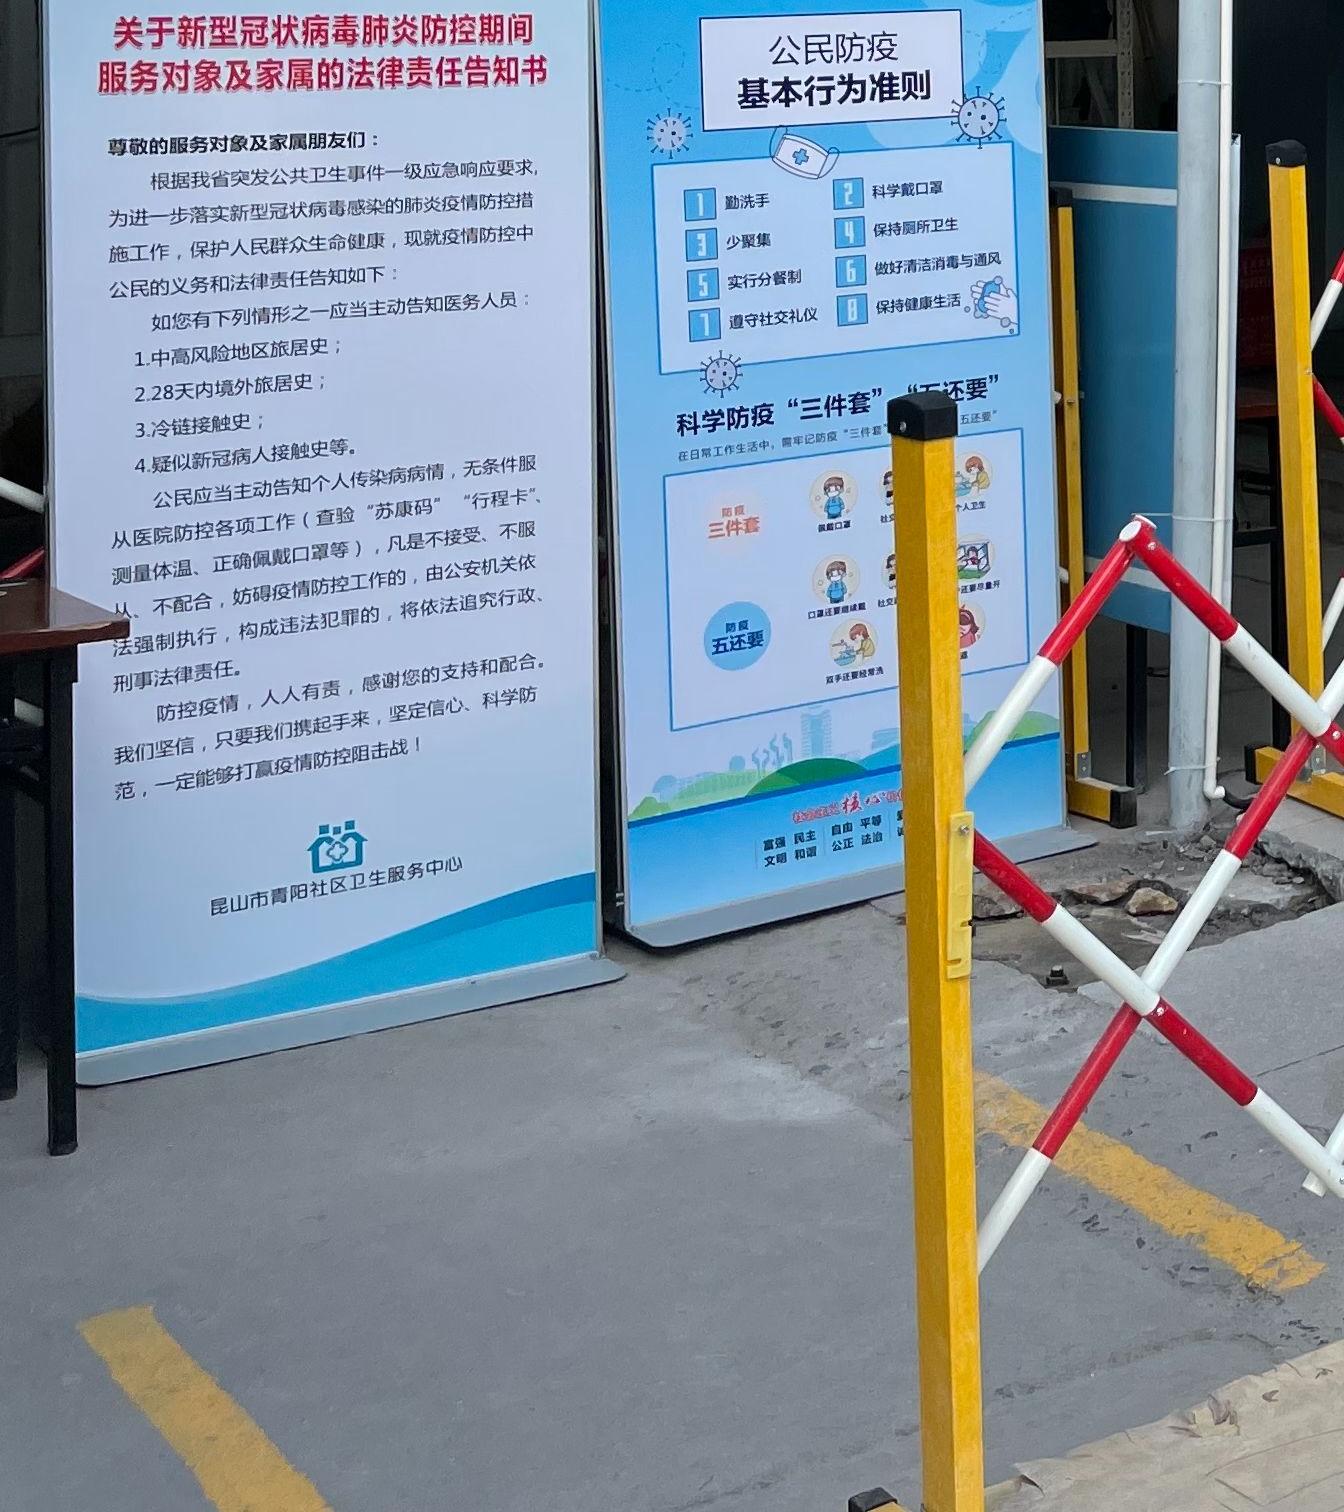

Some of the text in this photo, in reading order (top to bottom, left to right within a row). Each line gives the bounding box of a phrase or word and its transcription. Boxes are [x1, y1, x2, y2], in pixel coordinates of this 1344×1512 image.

[113, 12, 535, 51] 关于新型冠状病毒肺炎防控期间
[768, 30, 900, 66] 公民防疫
[97, 54, 549, 96] 服务对象及家属的法律责任告知书
[737, 69, 932, 110] 基本行为准则
[724, 191, 771, 211] 勤洗手
[871, 179, 944, 201] 科学戴口罩
[108, 191, 534, 229] 为进一步落实新型冠状病毒感染的肺炎疫情防控措
[873, 216, 959, 239] 保持厕所卫生
[726, 230, 772, 251] 少聚集
[874, 251, 1002, 278] 做好清洁消毒与通风
[727, 268, 802, 291] 实行分餐制
[875, 292, 962, 316] 保持健康生活
[729, 306, 818, 330] 遵守社交礼仪
[708, 516, 761, 540] 三件套
[725, 620, 750, 634] 防疫
[711, 630, 765, 656] 五还要
[832, 822, 852, 835] 自由
[832, 838, 853, 851] 公正
[209, 854, 464, 917] 昆山市青阳社区卫生服务中心
